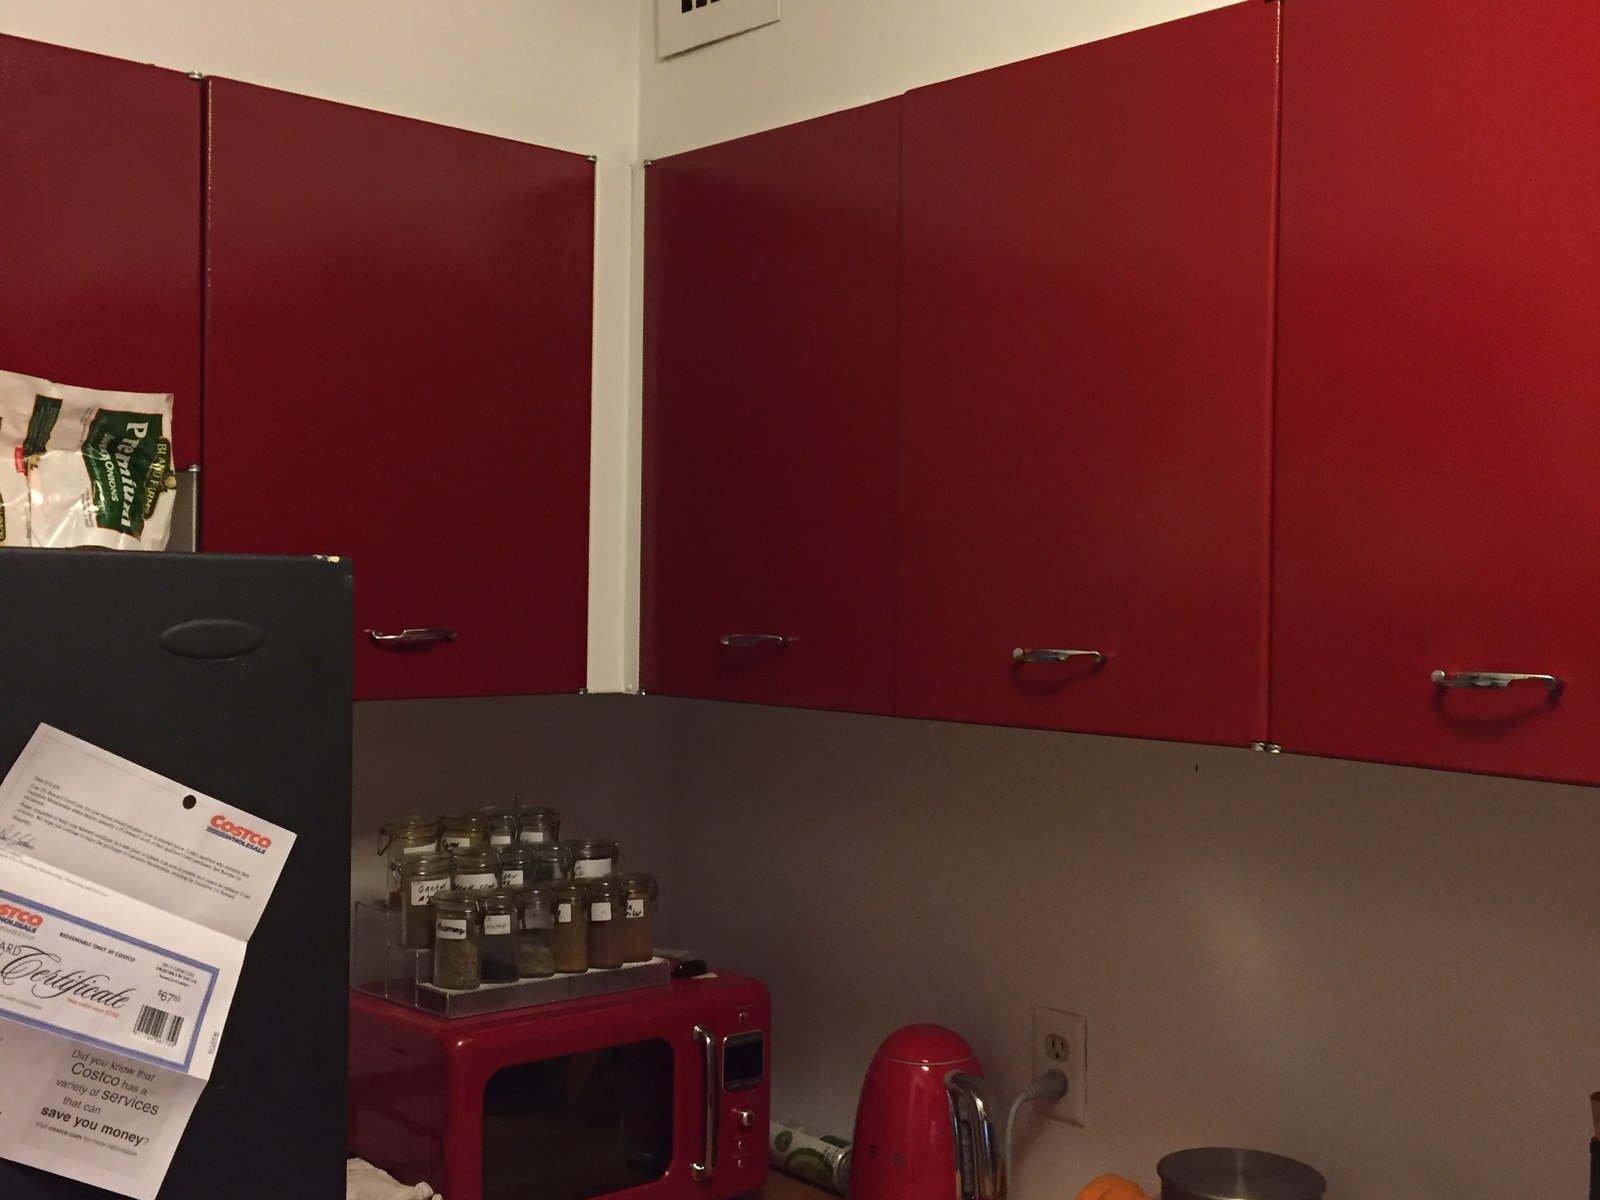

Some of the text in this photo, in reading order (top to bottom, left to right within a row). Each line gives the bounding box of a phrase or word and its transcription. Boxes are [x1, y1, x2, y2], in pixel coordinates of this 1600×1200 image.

[104, 460, 118, 502] ONIONS
[114, 422, 148, 527] Premium
[211, 815, 271, 849] COSTCO
[224, 833, 266, 855] WHOLESALE
[59, 932, 92, 947] REDEEMABLE
[92, 943, 107, 953] ONLY
[115, 951, 135, 962] COSTCO
[1, 945, 136, 1010] Certificate
[71, 1048, 156, 1082] Did you know that
[71, 1062, 148, 1096] Costco has a
[56, 1077, 160, 1116] variety of services
[62, 1095, 102, 1115] that can
[40, 1105, 150, 1147] save you money?
